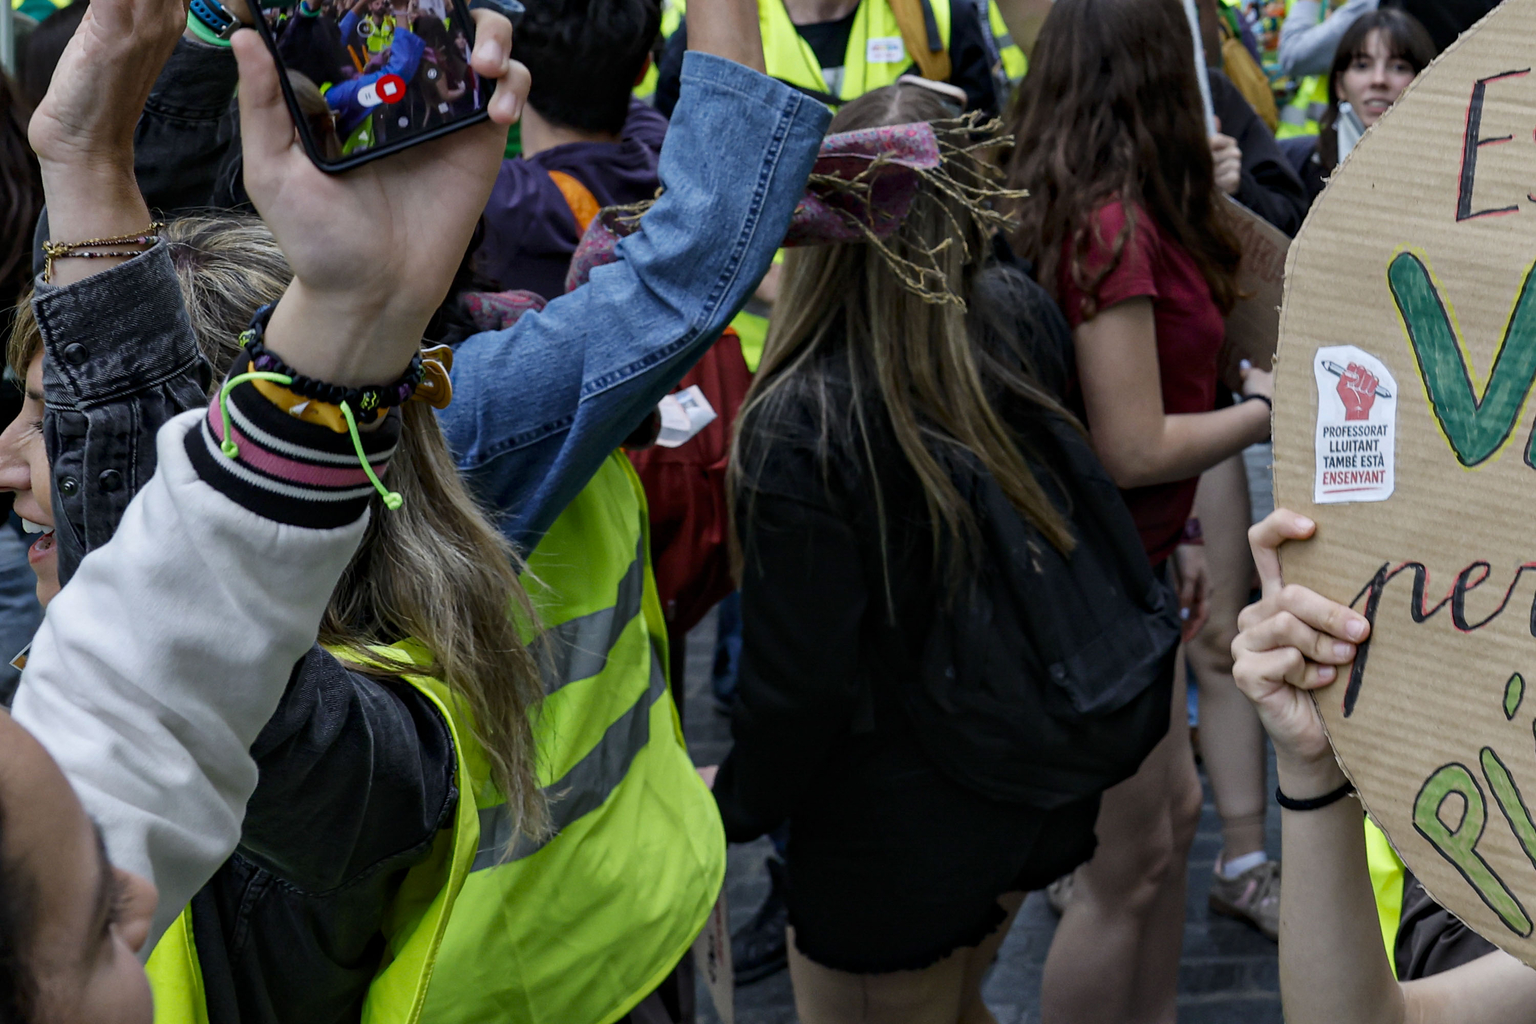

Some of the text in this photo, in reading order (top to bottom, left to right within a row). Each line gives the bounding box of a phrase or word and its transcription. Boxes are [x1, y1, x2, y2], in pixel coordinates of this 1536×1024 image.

[1322, 425, 1388, 438] PROFESSORAT
[1329, 439, 1380, 454] LLUITANT
[1323, 451, 1385, 470] TAMBÉ ESTÀ
[1322, 470, 1386, 486] ENSENYANT
